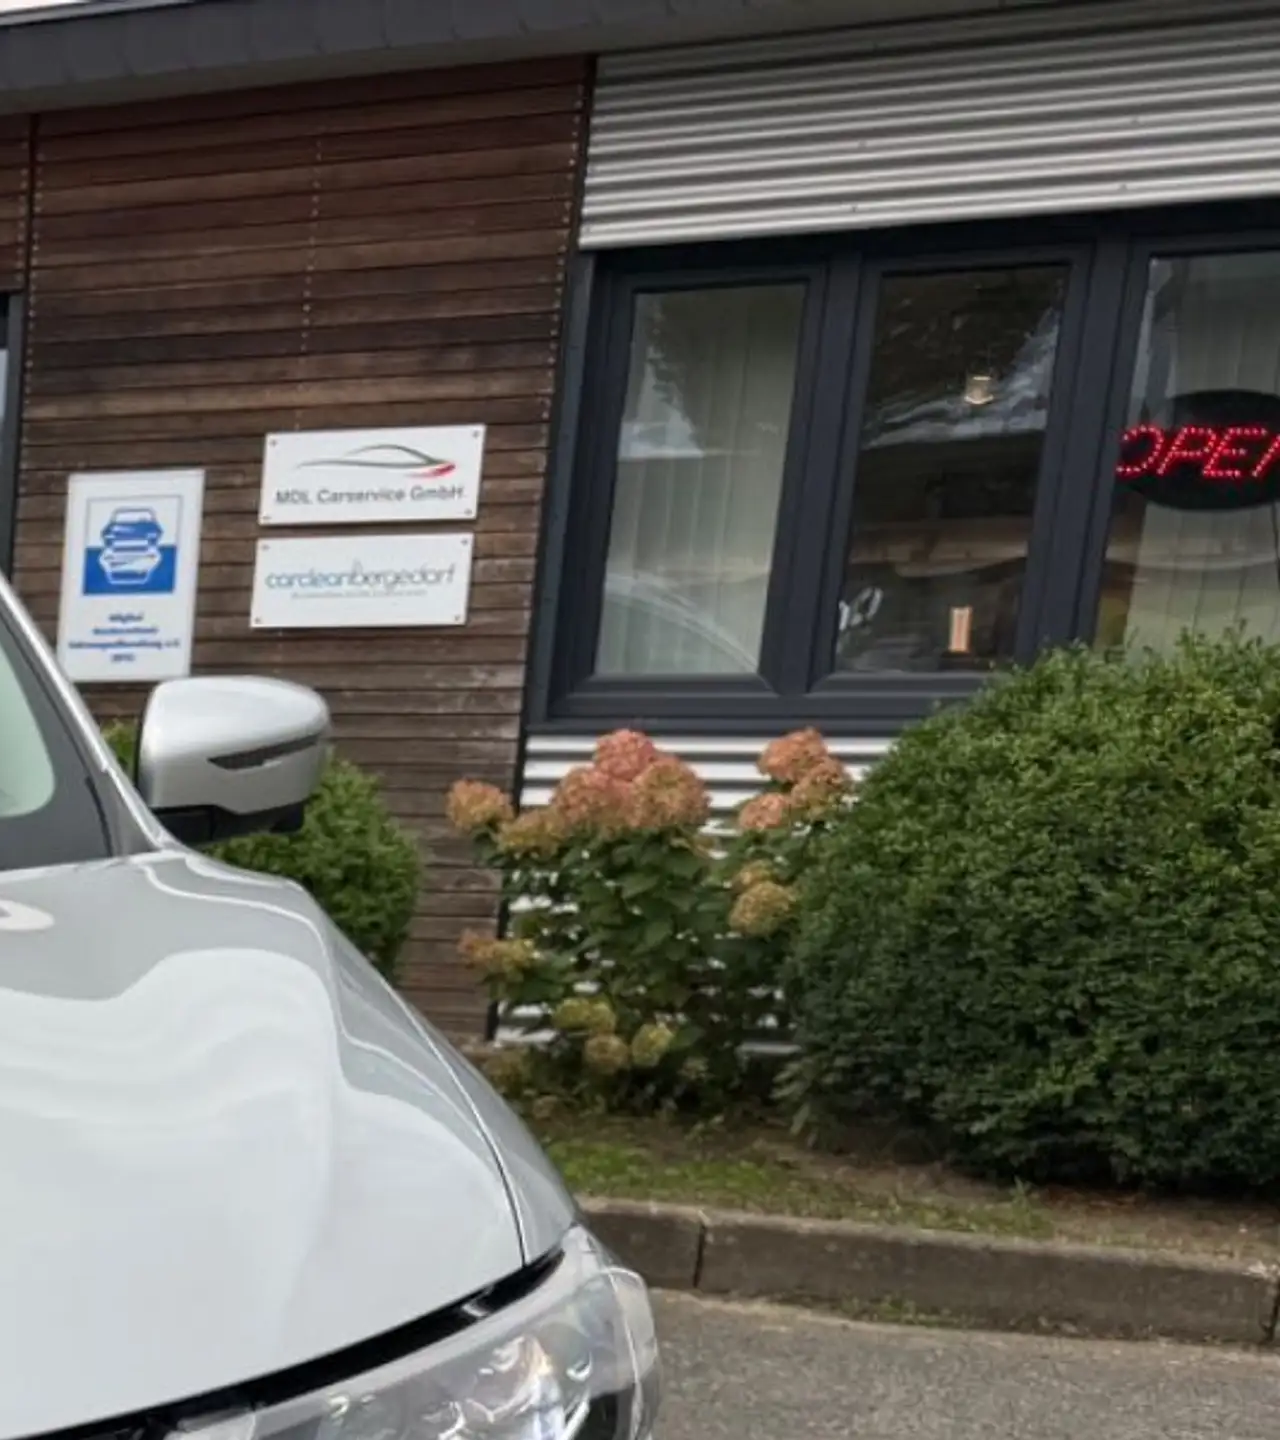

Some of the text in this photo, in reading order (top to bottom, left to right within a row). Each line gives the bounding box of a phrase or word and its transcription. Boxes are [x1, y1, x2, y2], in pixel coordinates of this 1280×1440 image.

[275, 484, 465, 504] MDL Carservice GmbH
